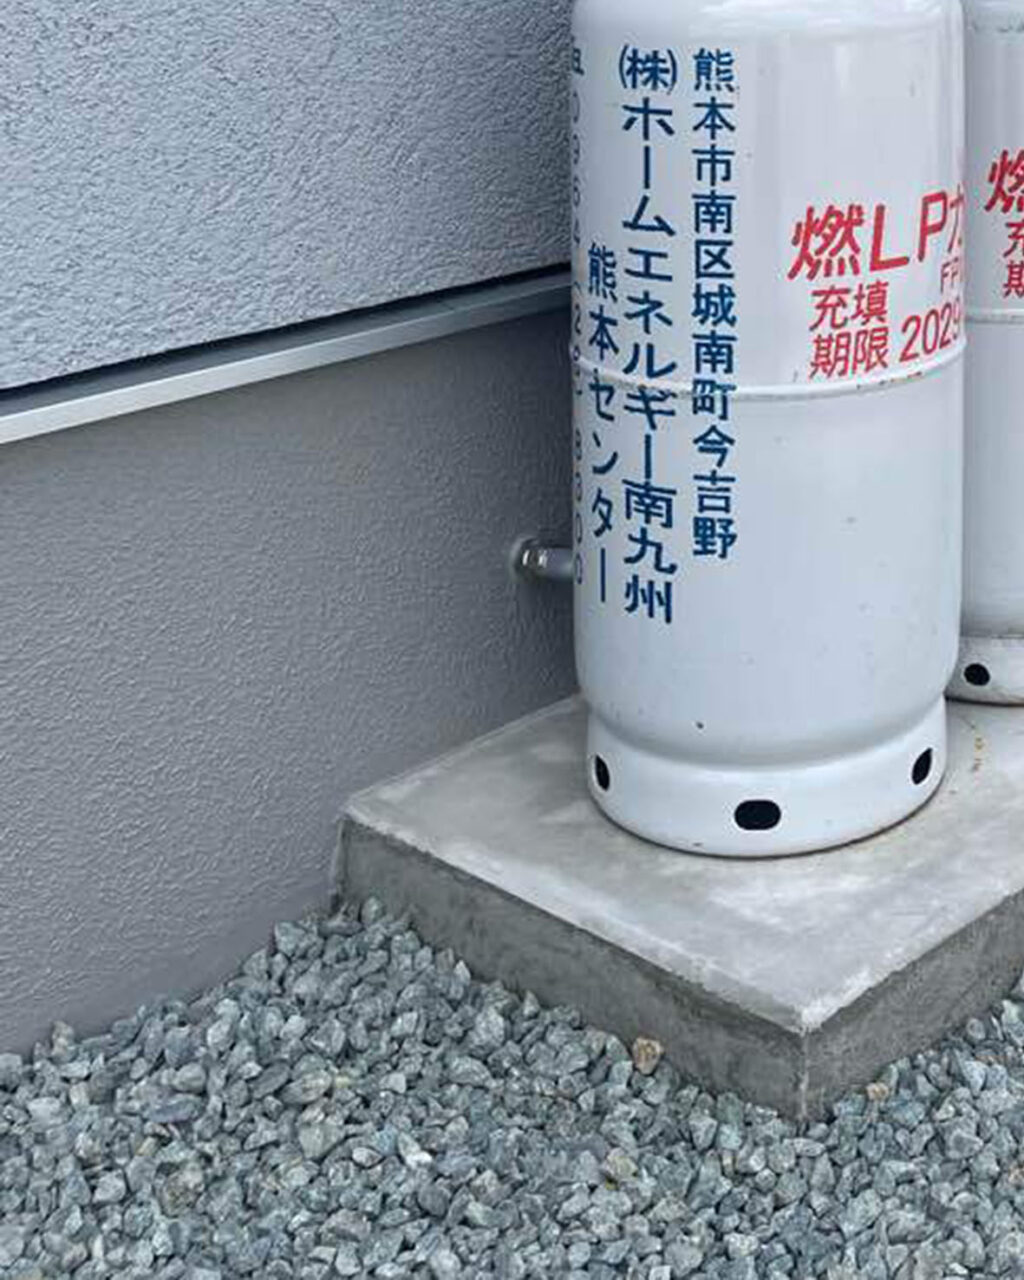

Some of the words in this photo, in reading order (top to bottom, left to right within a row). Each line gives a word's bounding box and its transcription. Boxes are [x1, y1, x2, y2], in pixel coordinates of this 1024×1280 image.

[691, 47, 738, 560] 熊本市南区城南町今吉野
[808, 281, 889, 331] 充填
[808, 326, 890, 380] 期限
[587, 241, 619, 604] 熊本センター
